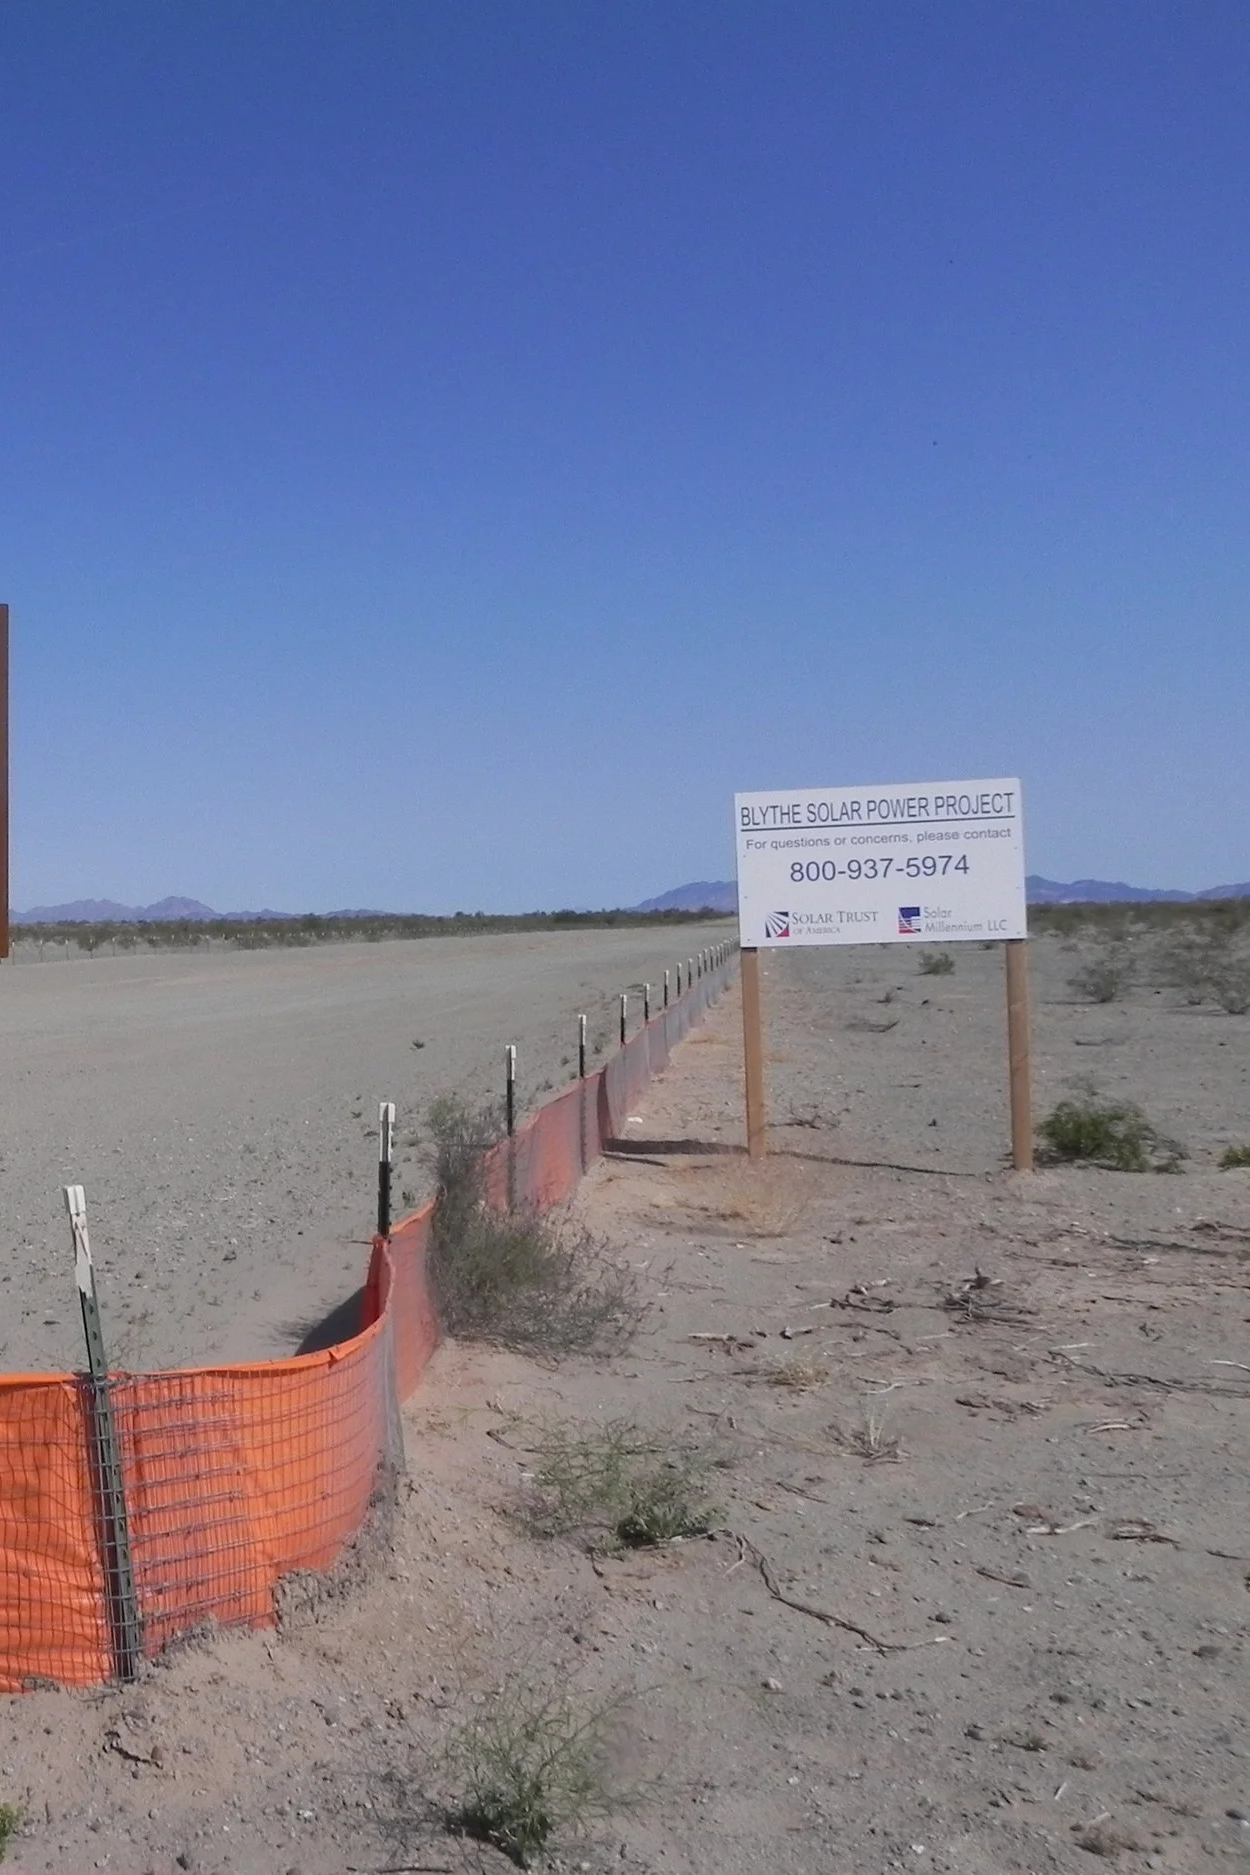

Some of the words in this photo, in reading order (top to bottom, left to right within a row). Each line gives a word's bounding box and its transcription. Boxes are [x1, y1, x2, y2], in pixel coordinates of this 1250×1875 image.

[741, 804, 802, 826] BLYTHE
[806, 800, 862, 823] SOLAR
[866, 797, 929, 820] POWER
[934, 792, 1013, 816] PROJECT
[746, 839, 766, 849] For
[771, 837, 830, 850] questions
[834, 836, 846, 846] or
[917, 830, 959, 844] please
[964, 828, 1011, 840] contact
[790, 854, 970, 882] 800-937-5974
[924, 908, 952, 918] Solar
[925, 922, 982, 932] Millennium
[988, 920, 1006, 931] LLC
